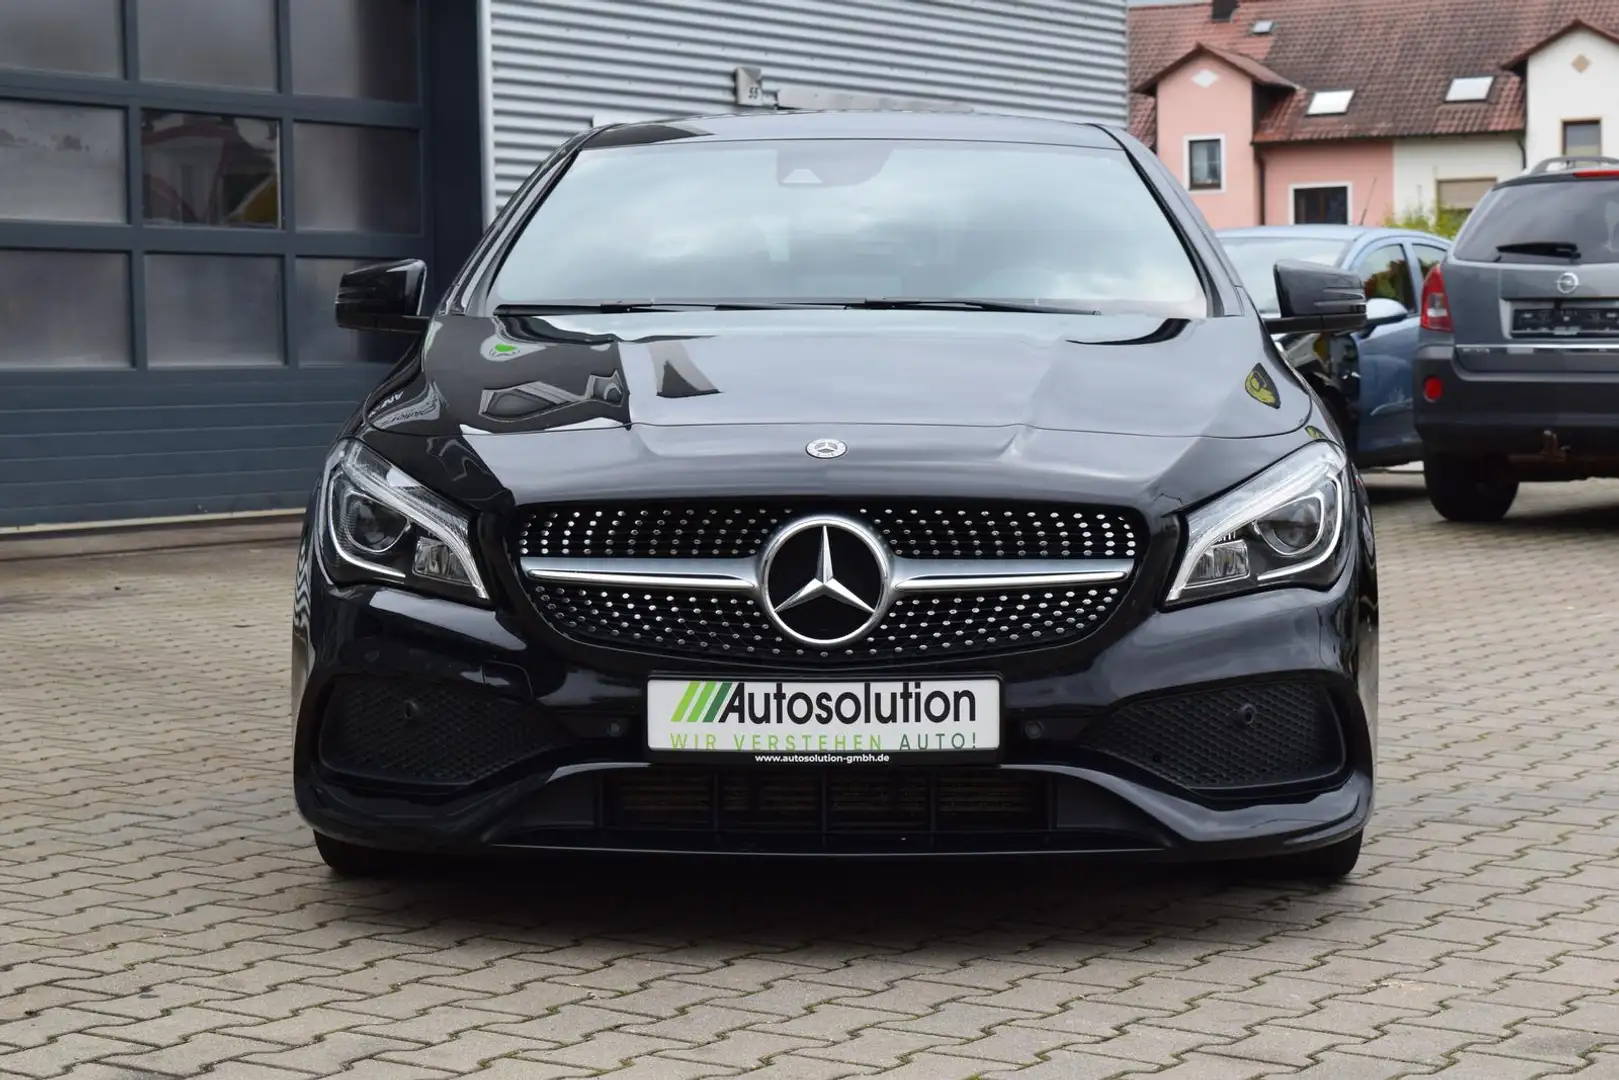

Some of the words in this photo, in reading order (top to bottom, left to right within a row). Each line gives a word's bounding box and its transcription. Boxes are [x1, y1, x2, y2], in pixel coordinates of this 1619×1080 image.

[718, 682, 976, 725] Autosolution
[670, 733, 717, 751] WIR
[734, 733, 882, 751] VERSTEHEN
[899, 733, 977, 750] AUTO!
[755, 753, 890, 764] www.autosolution-gmbh.de
